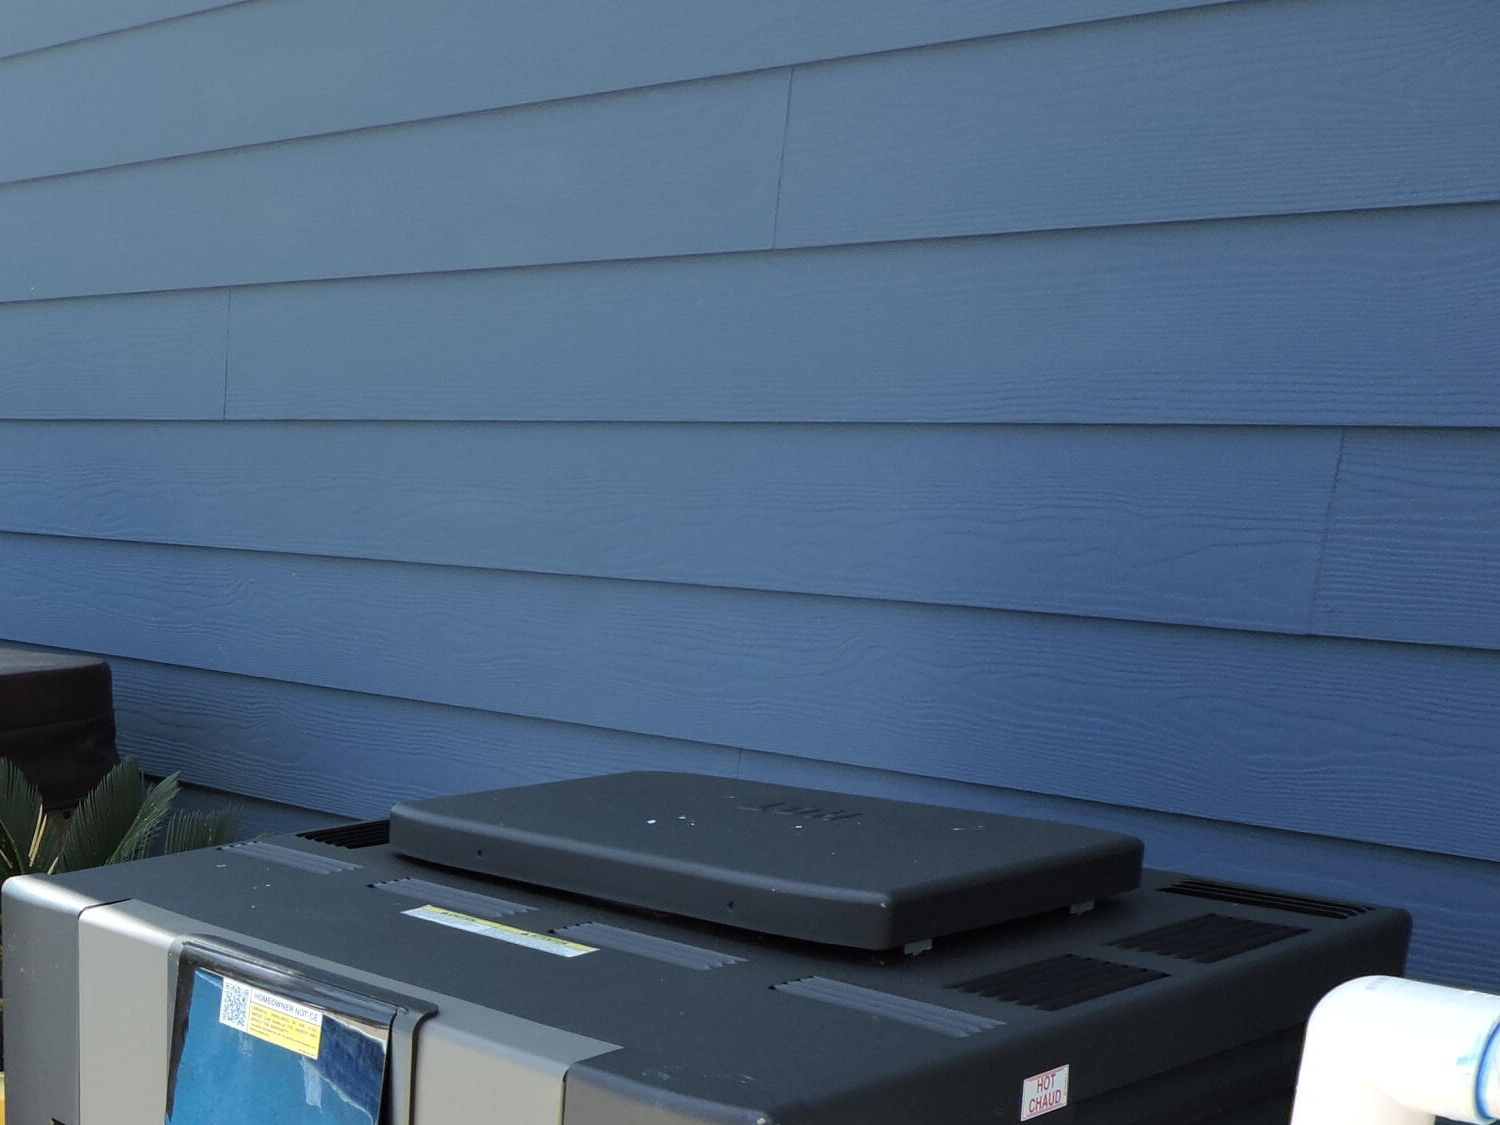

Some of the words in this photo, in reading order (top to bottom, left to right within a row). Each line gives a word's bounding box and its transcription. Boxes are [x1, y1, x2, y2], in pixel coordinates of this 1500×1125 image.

[254, 993, 294, 1012] HOMEOWNER
[295, 1007, 319, 1022] NOTICE
[1037, 1073, 1056, 1093] HOT
[1029, 1090, 1061, 1113] CHAUD
